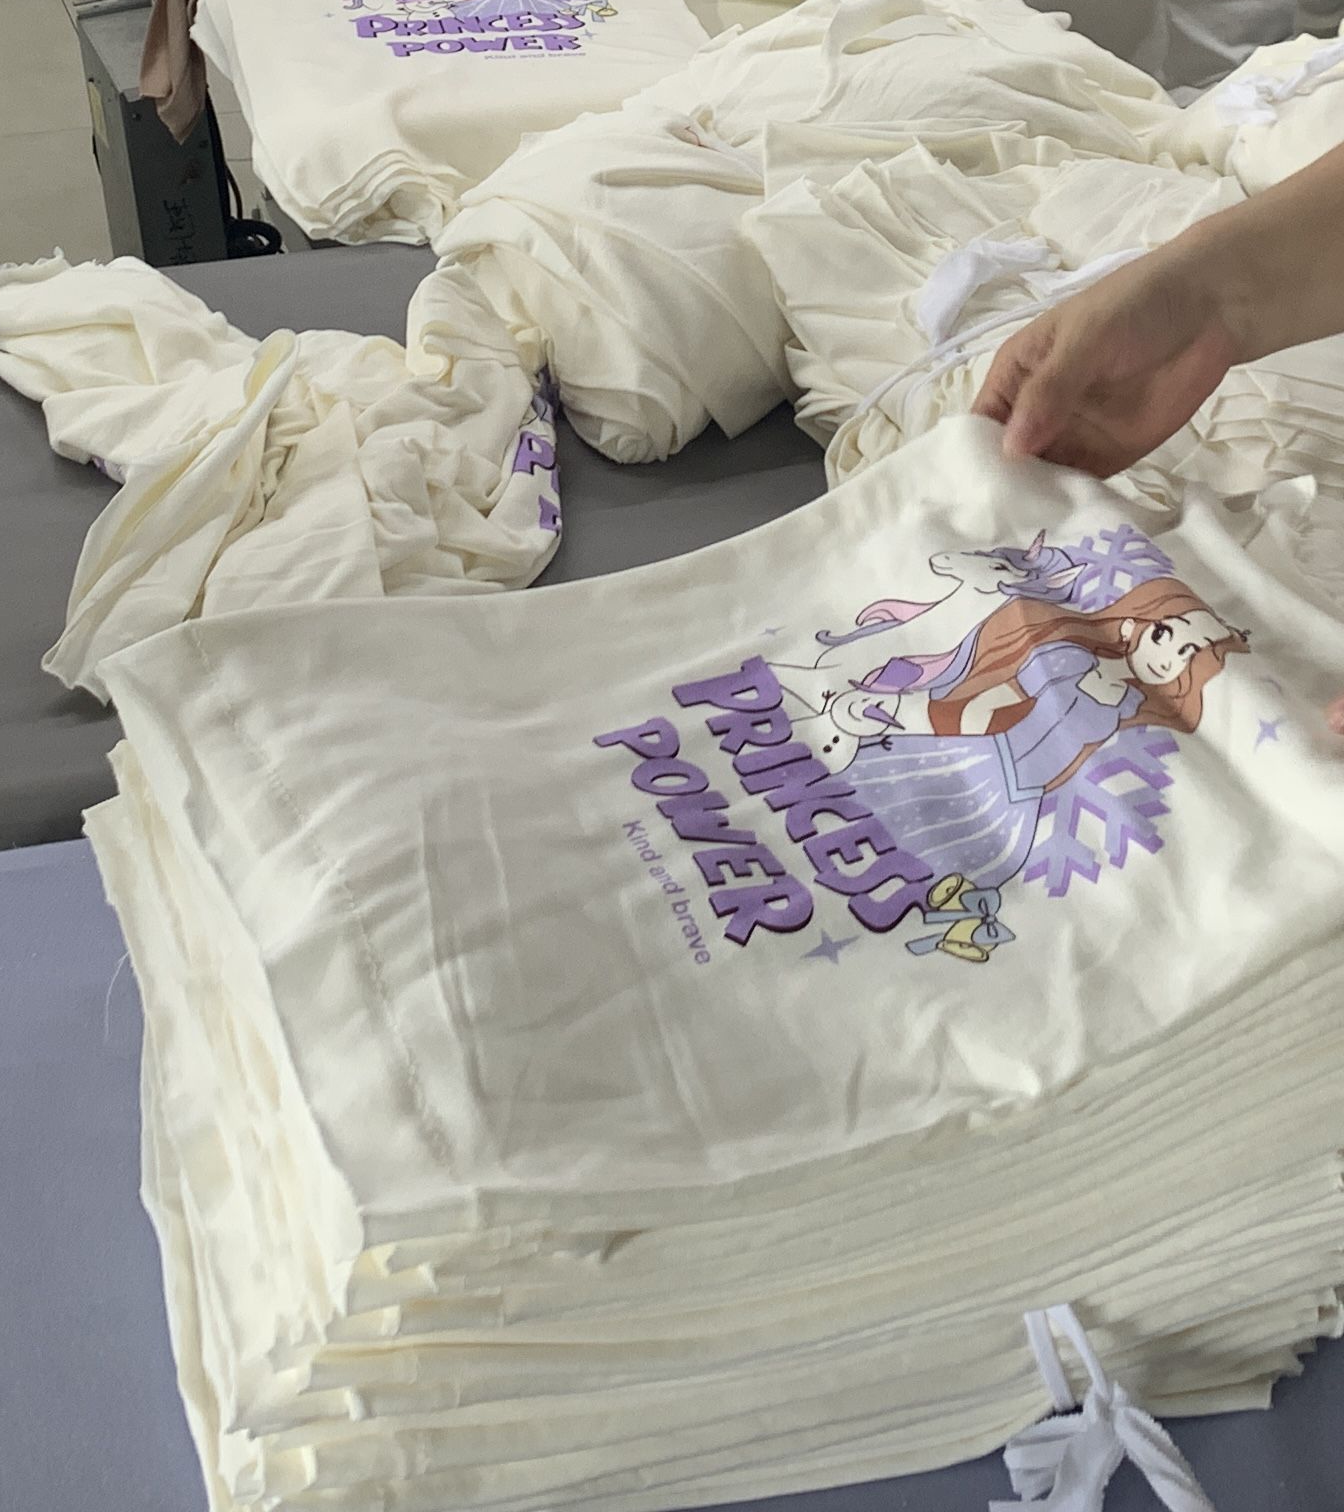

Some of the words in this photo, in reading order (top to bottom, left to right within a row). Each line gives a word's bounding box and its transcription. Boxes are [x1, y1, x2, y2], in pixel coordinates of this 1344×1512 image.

[350, 12, 586, 37] PRINCESS
[386, 34, 582, 57] POWER
[592, 716, 815, 947] POWER
[672, 654, 934, 933] PRINCESS
[622, 820, 663, 862] Kind
[648, 866, 685, 895] and
[671, 899, 711, 965] brave
